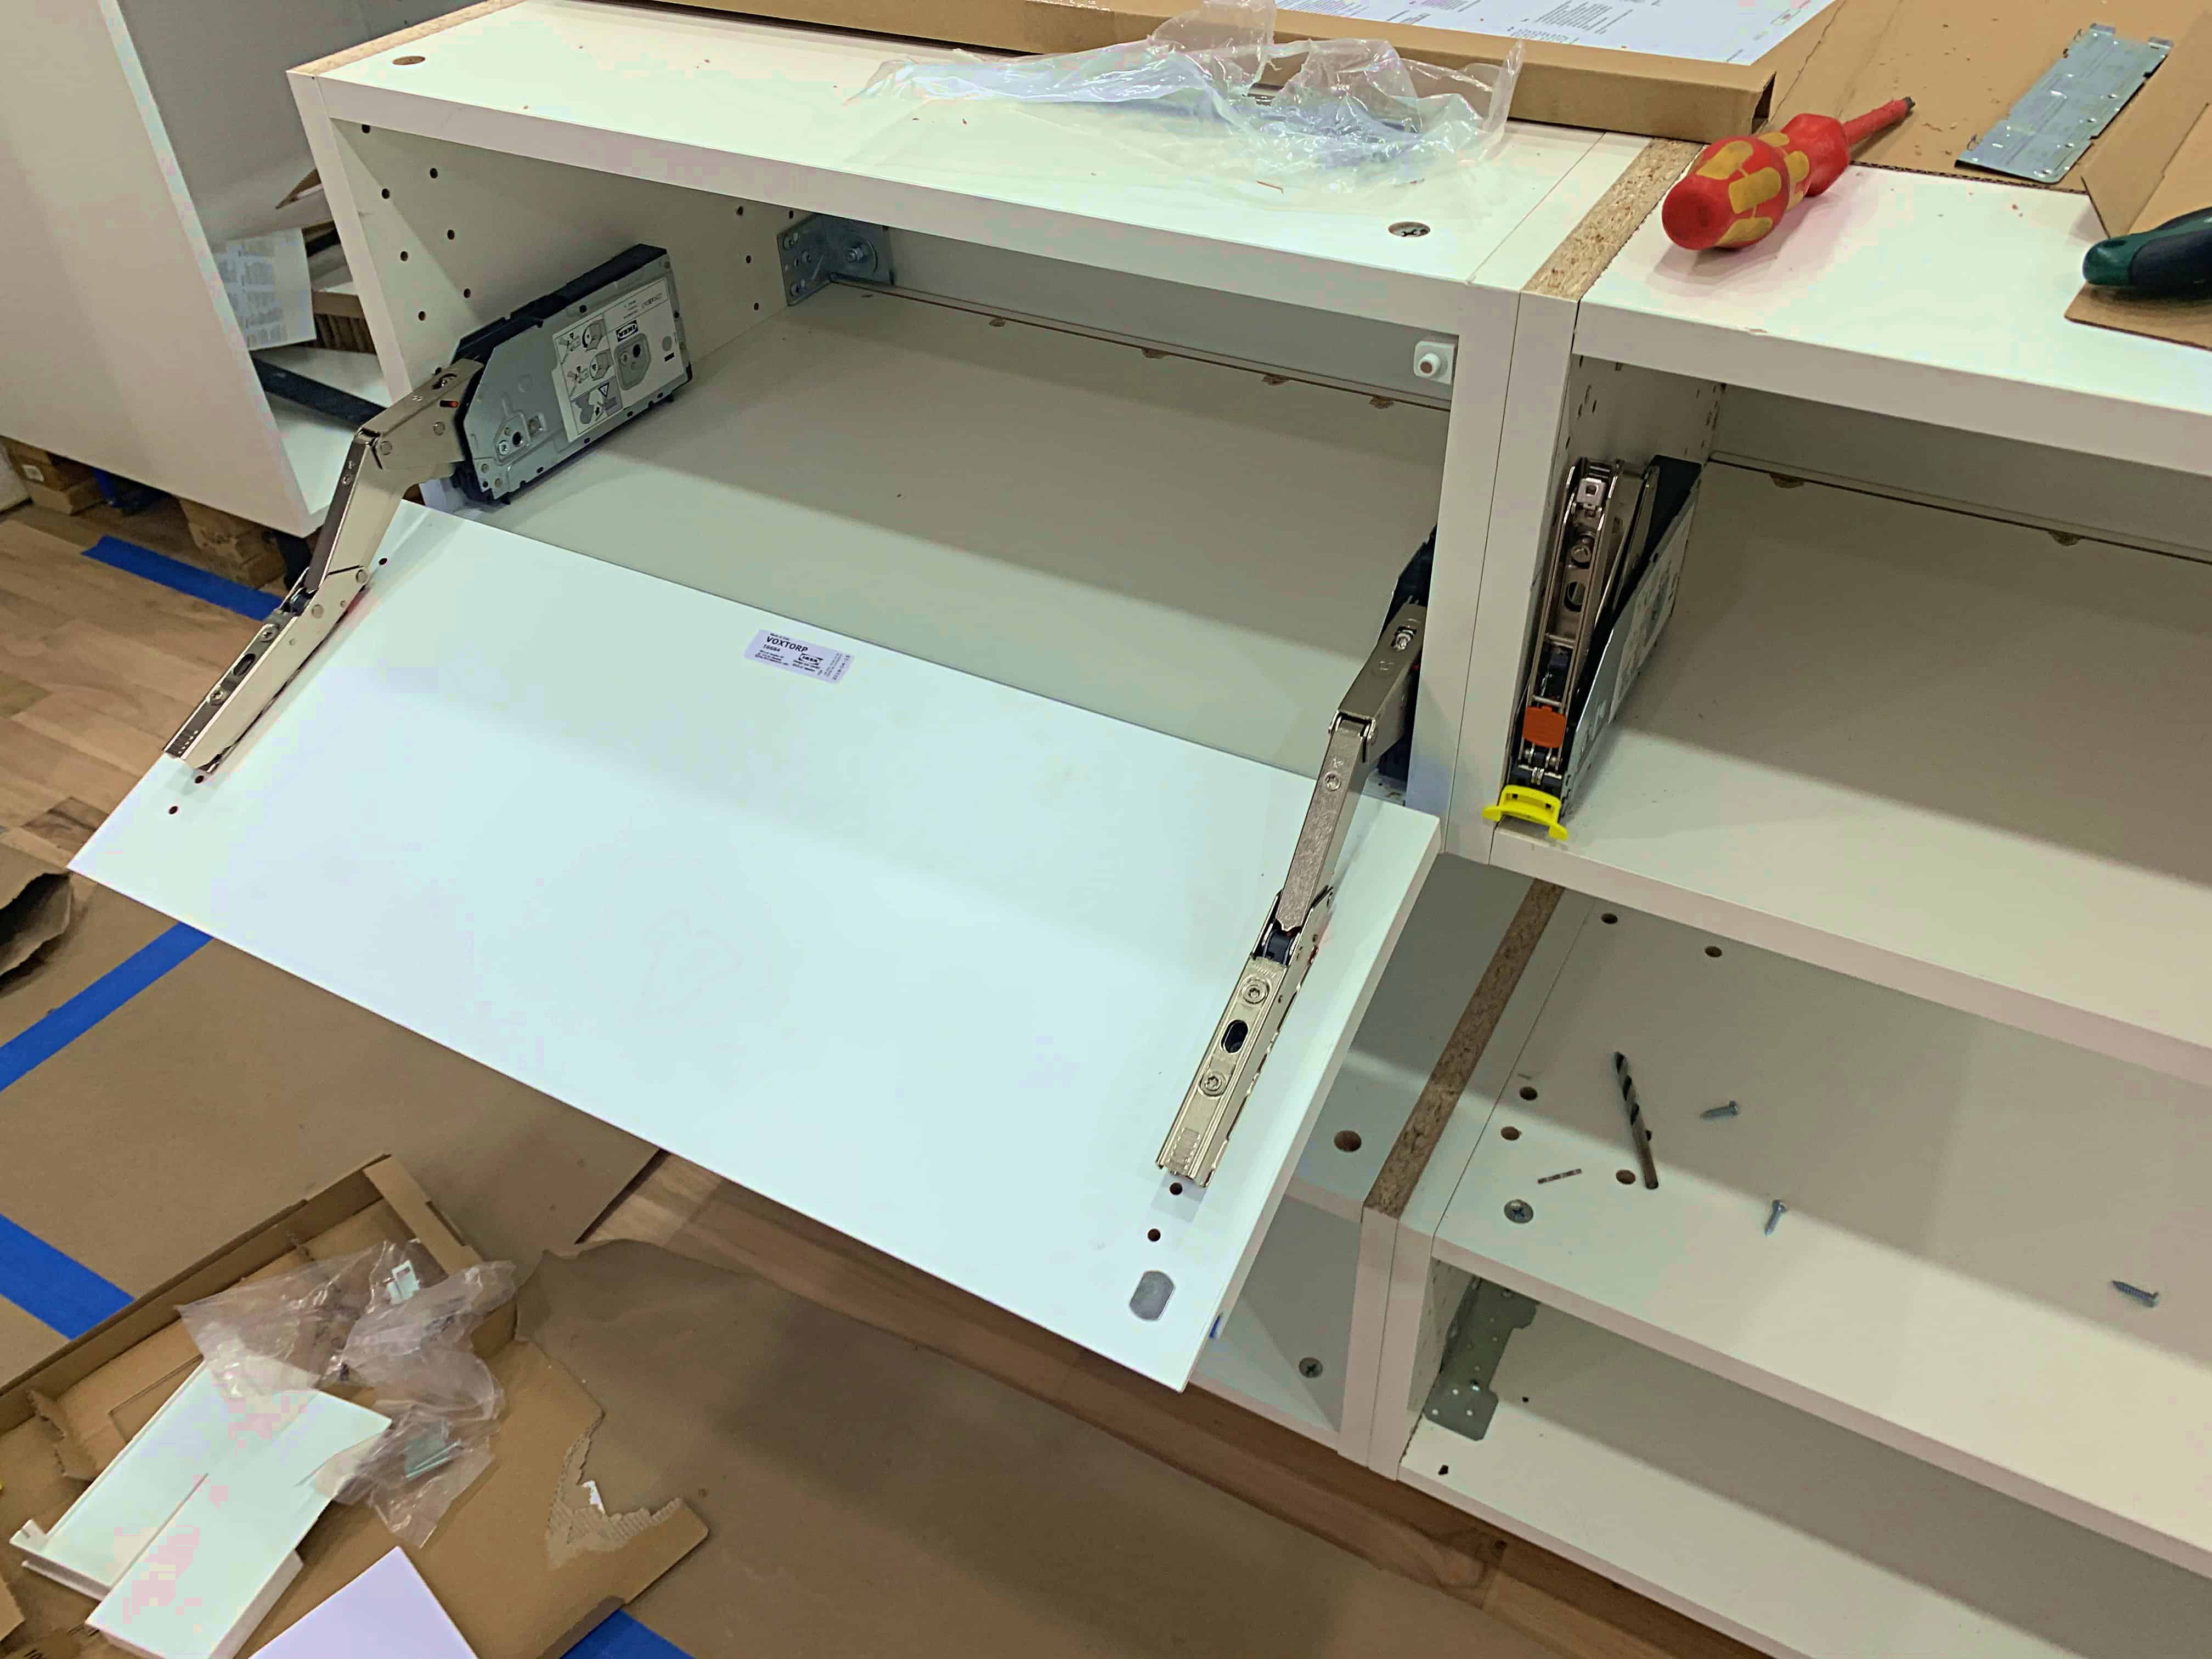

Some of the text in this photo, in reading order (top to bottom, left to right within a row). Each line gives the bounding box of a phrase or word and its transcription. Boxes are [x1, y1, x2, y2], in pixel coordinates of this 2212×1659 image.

[618, 323, 637, 338] IKEA
[766, 636, 808, 652] VOXTORP
[800, 654, 820, 664] IKEA
